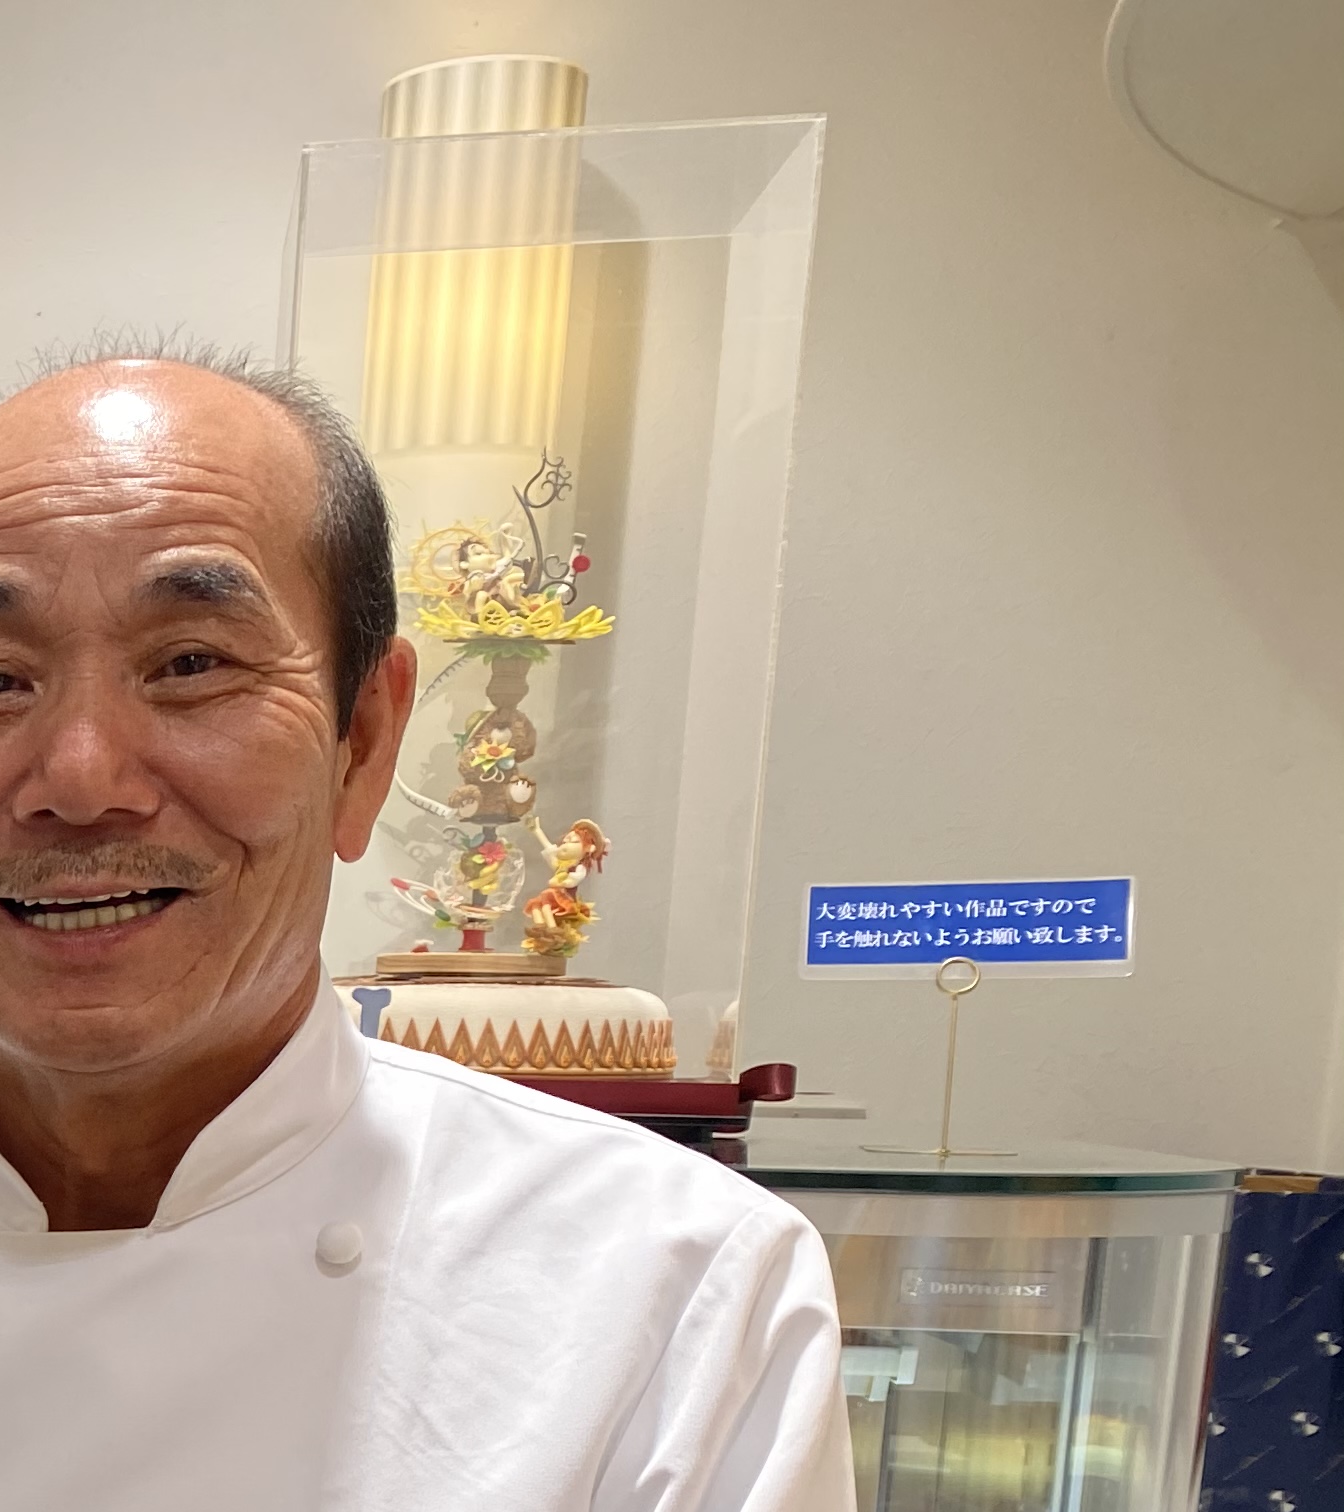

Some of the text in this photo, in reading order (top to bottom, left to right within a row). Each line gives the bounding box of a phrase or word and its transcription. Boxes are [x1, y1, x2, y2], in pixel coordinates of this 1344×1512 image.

[815, 897, 1097, 921] 大変壊れやすい作品ですので
[814, 924, 1123, 949] 手を触れないようお願い致します。
